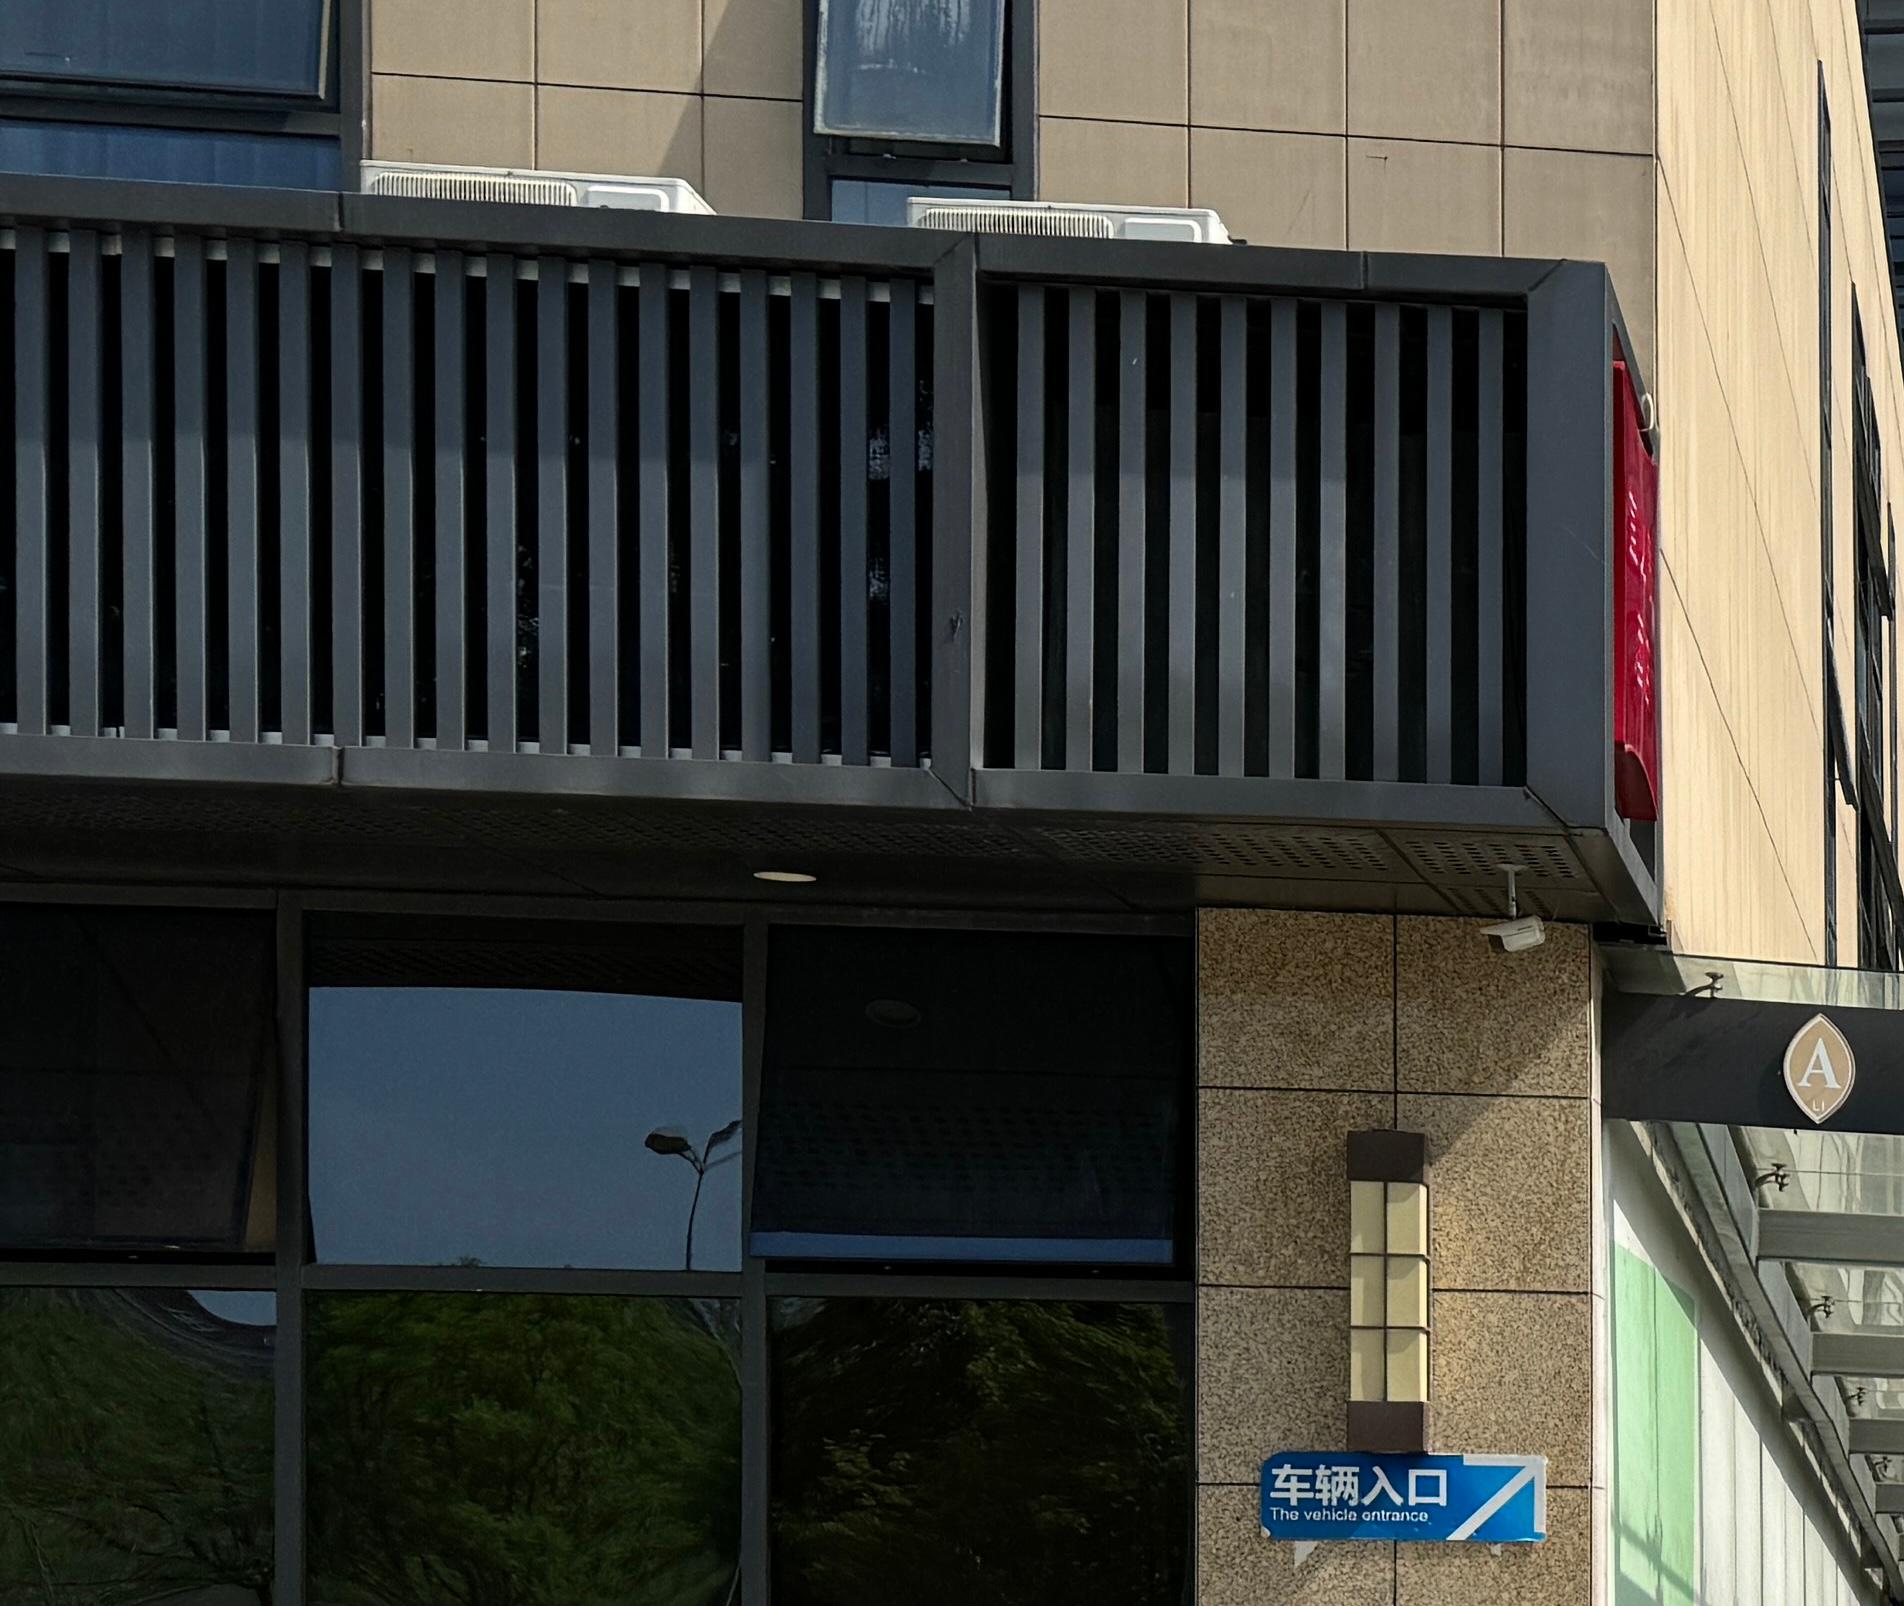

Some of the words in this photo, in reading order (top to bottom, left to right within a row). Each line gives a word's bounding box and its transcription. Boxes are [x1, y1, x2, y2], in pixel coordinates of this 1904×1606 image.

[1797, 1037, 1841, 1089] A
[1270, 1464, 1447, 1507] 车辆入口
[1270, 1507, 1299, 1521] The
[1304, 1508, 1358, 1521] vehicle
[1361, 1509, 1429, 1522] entrance
